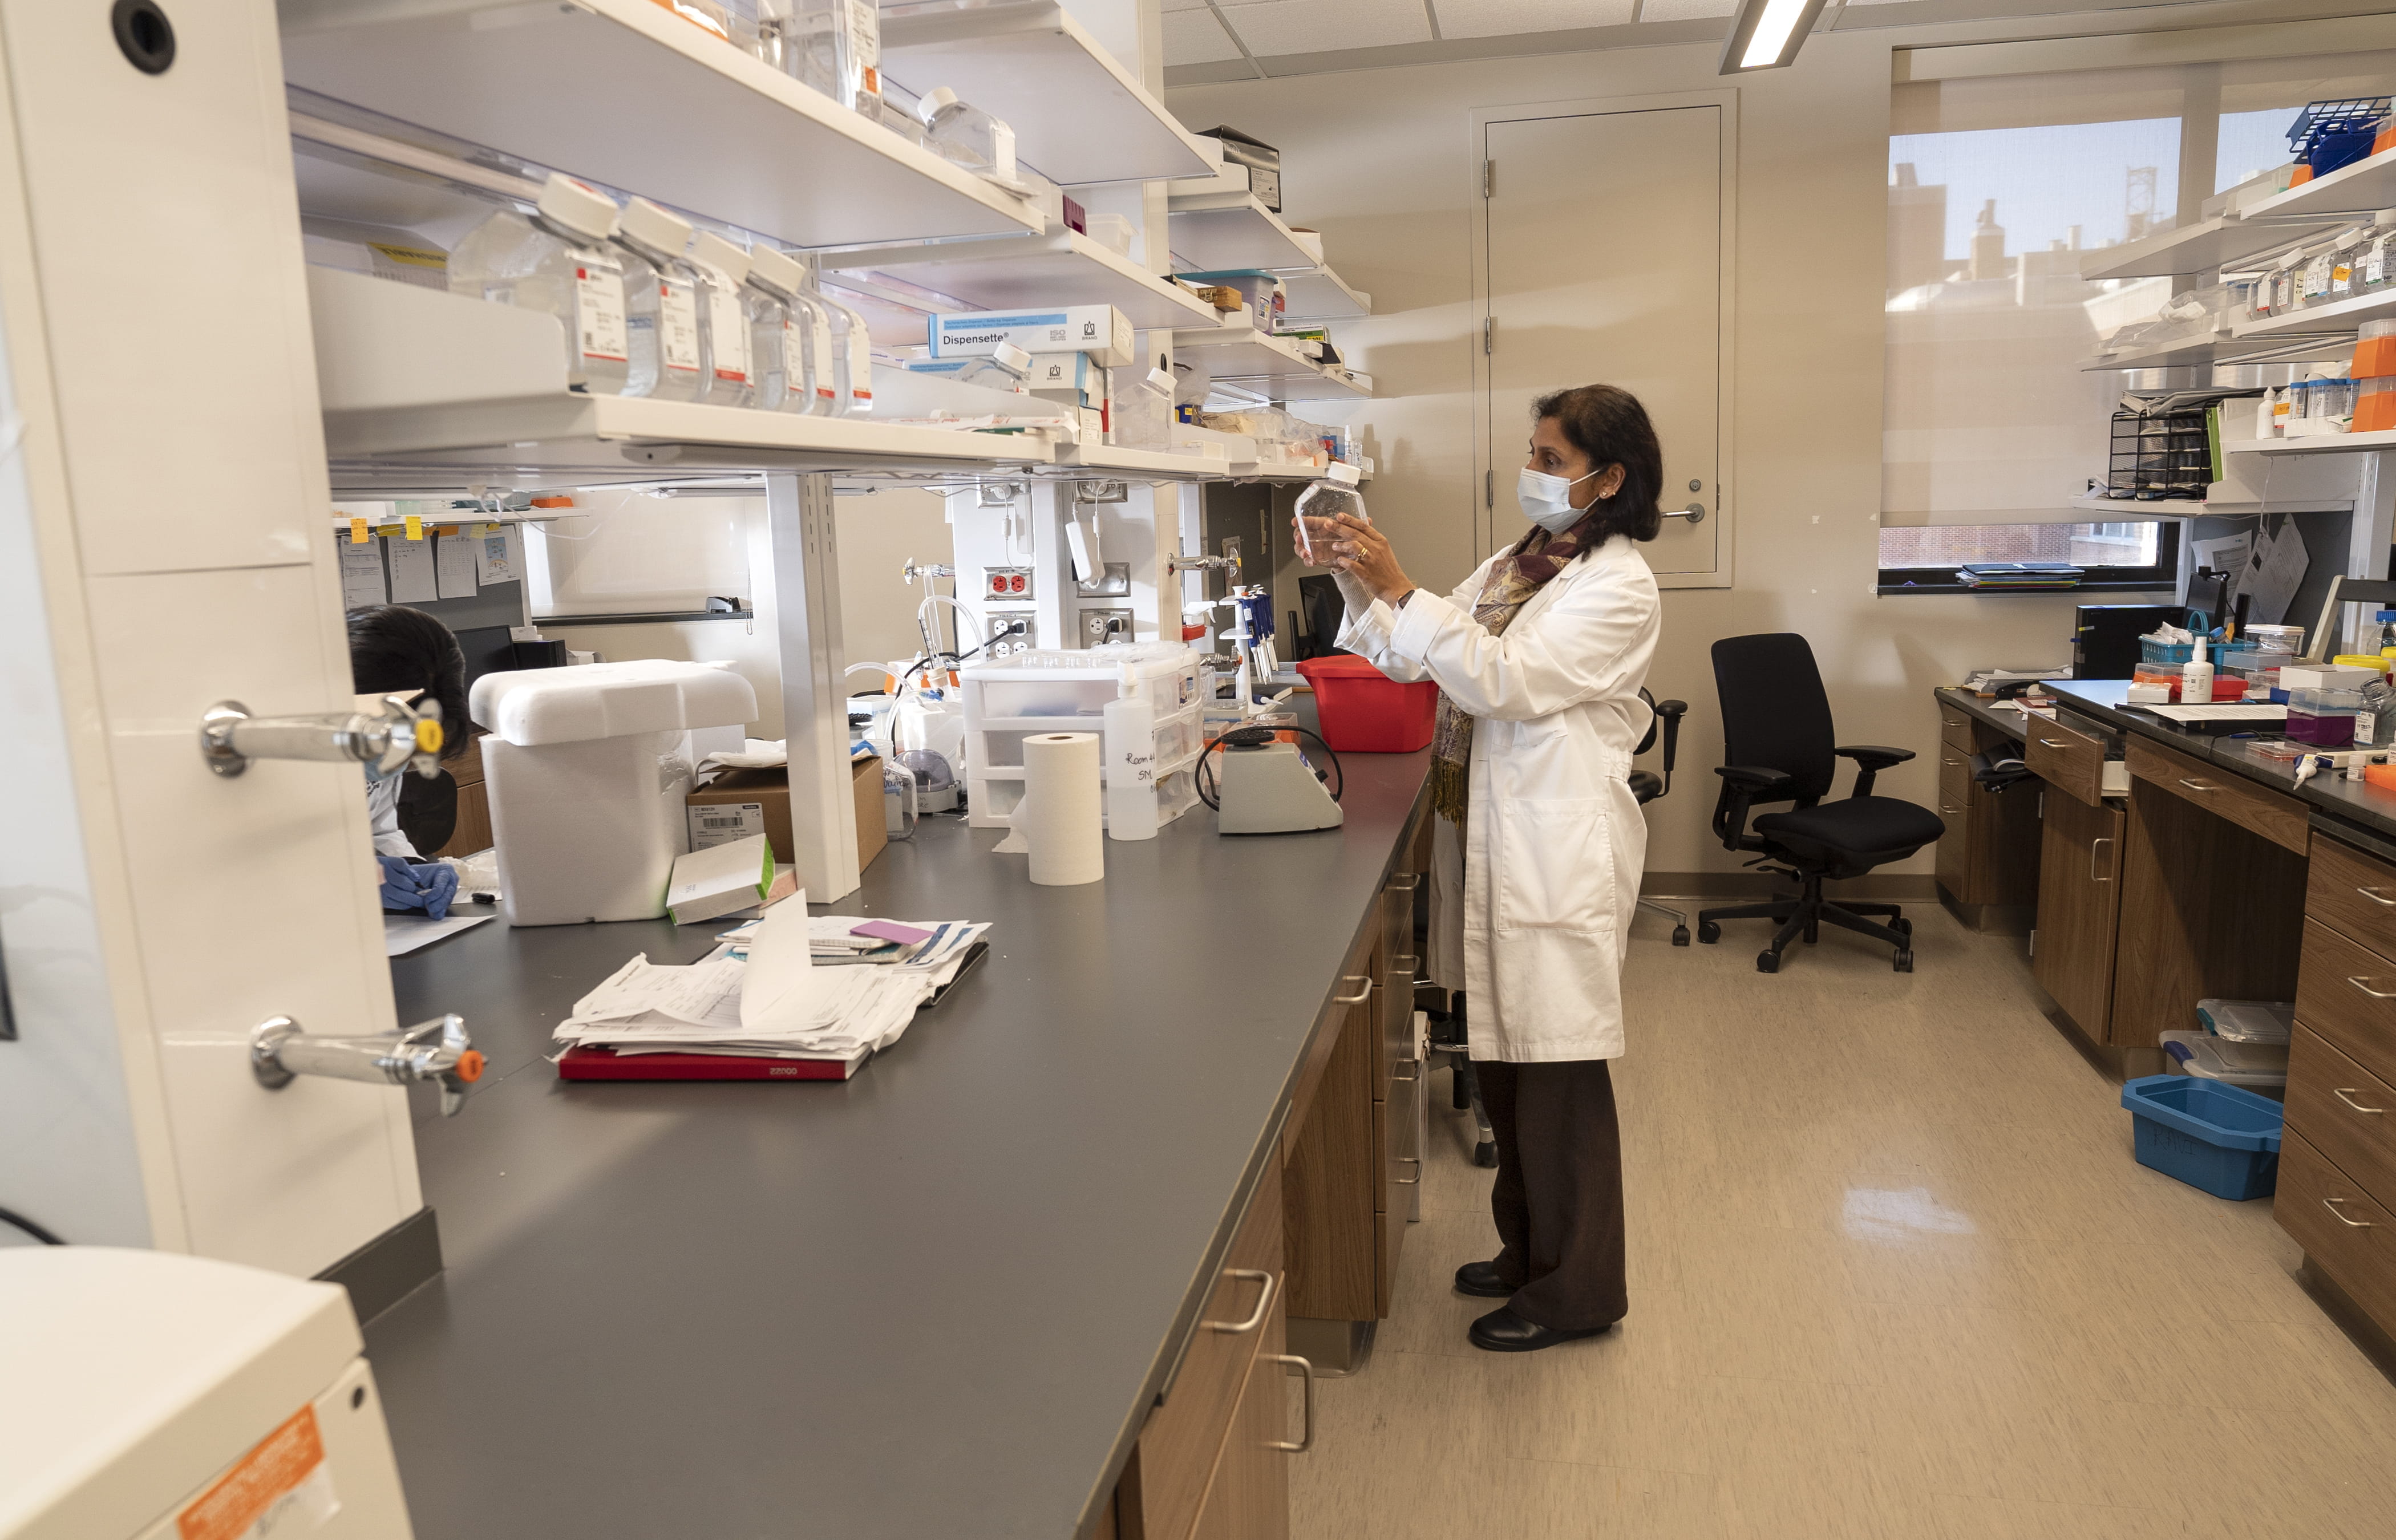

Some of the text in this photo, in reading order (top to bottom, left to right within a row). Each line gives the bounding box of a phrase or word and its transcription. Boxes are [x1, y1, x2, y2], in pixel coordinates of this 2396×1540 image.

[1126, 753, 1148, 765] Room
[1138, 770, 1153, 781] SM
[2151, 1126, 2198, 1156] RAVI
